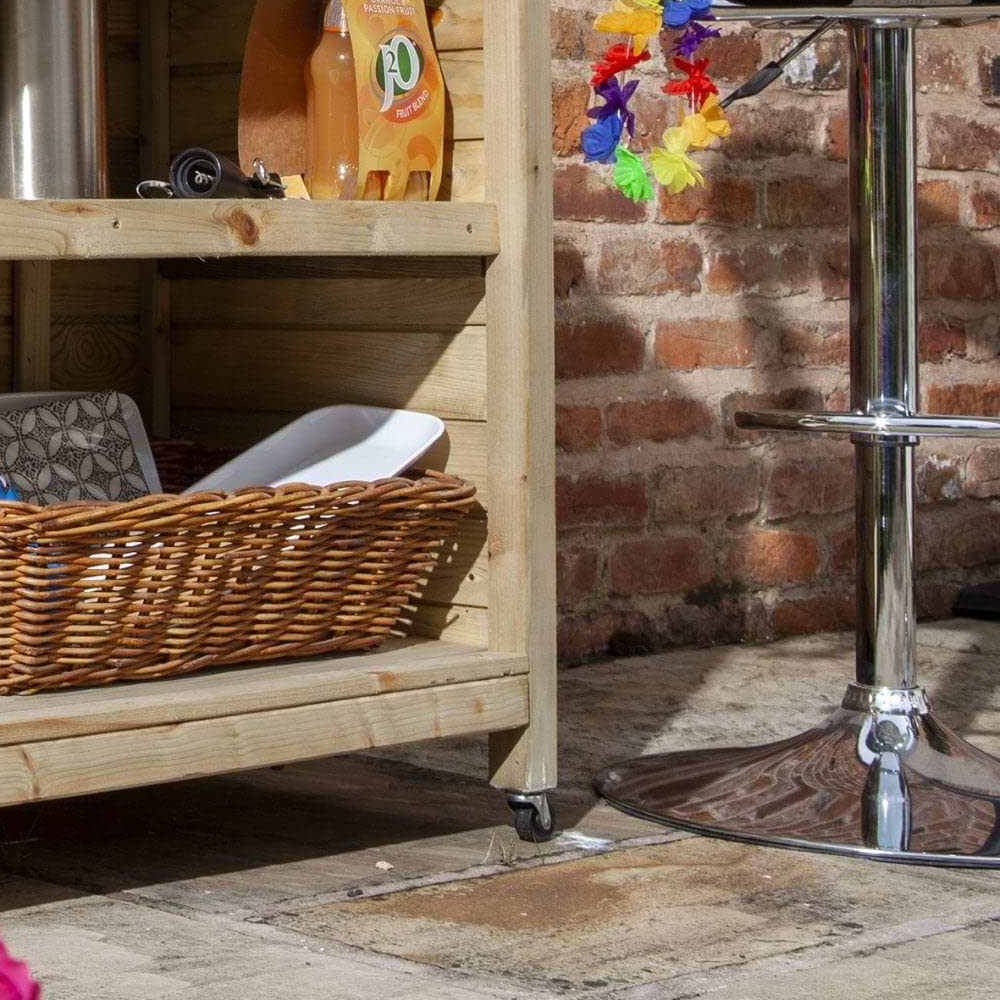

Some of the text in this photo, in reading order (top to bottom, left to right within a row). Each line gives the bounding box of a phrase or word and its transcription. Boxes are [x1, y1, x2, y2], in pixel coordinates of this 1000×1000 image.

[363, 3, 415, 17] PASSION FRUIT
[395, 89, 430, 119] FRUIT BLEND
